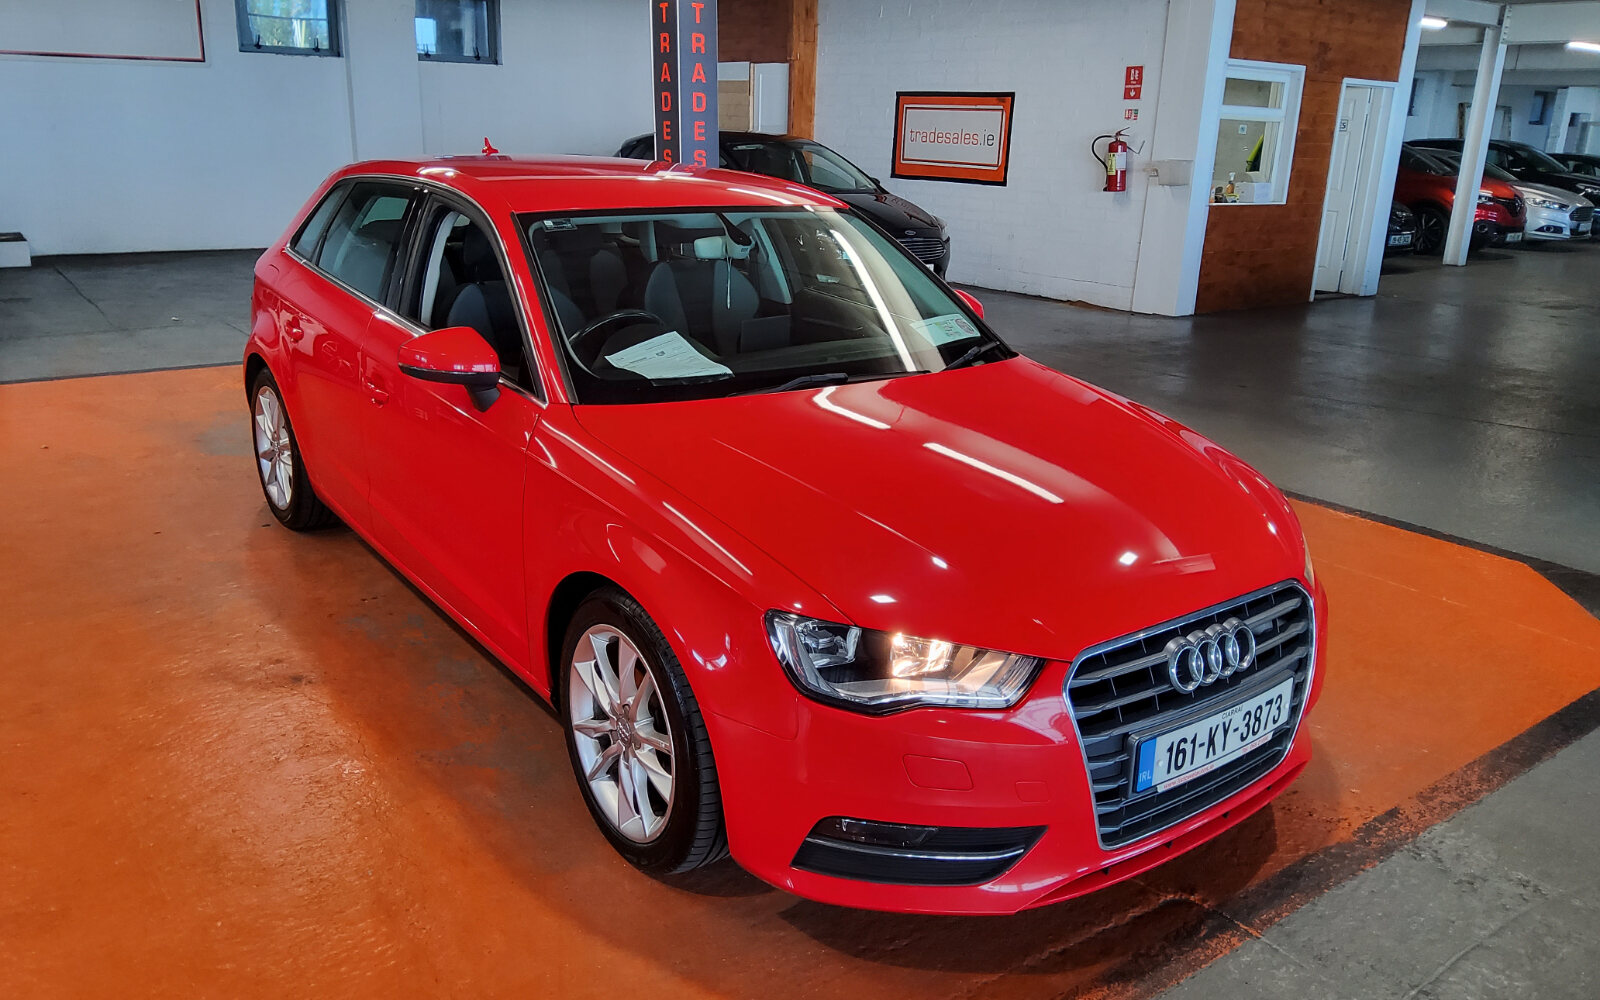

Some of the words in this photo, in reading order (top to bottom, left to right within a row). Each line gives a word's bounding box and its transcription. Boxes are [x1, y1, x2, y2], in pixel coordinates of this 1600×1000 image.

[659, 2, 673, 164] TRADES
[691, 2, 707, 168] TRADES
[909, 127, 995, 147] tradesales.ie
[1166, 693, 1283, 775] 161-KY-3873
[1138, 770, 1152, 783] IRL
